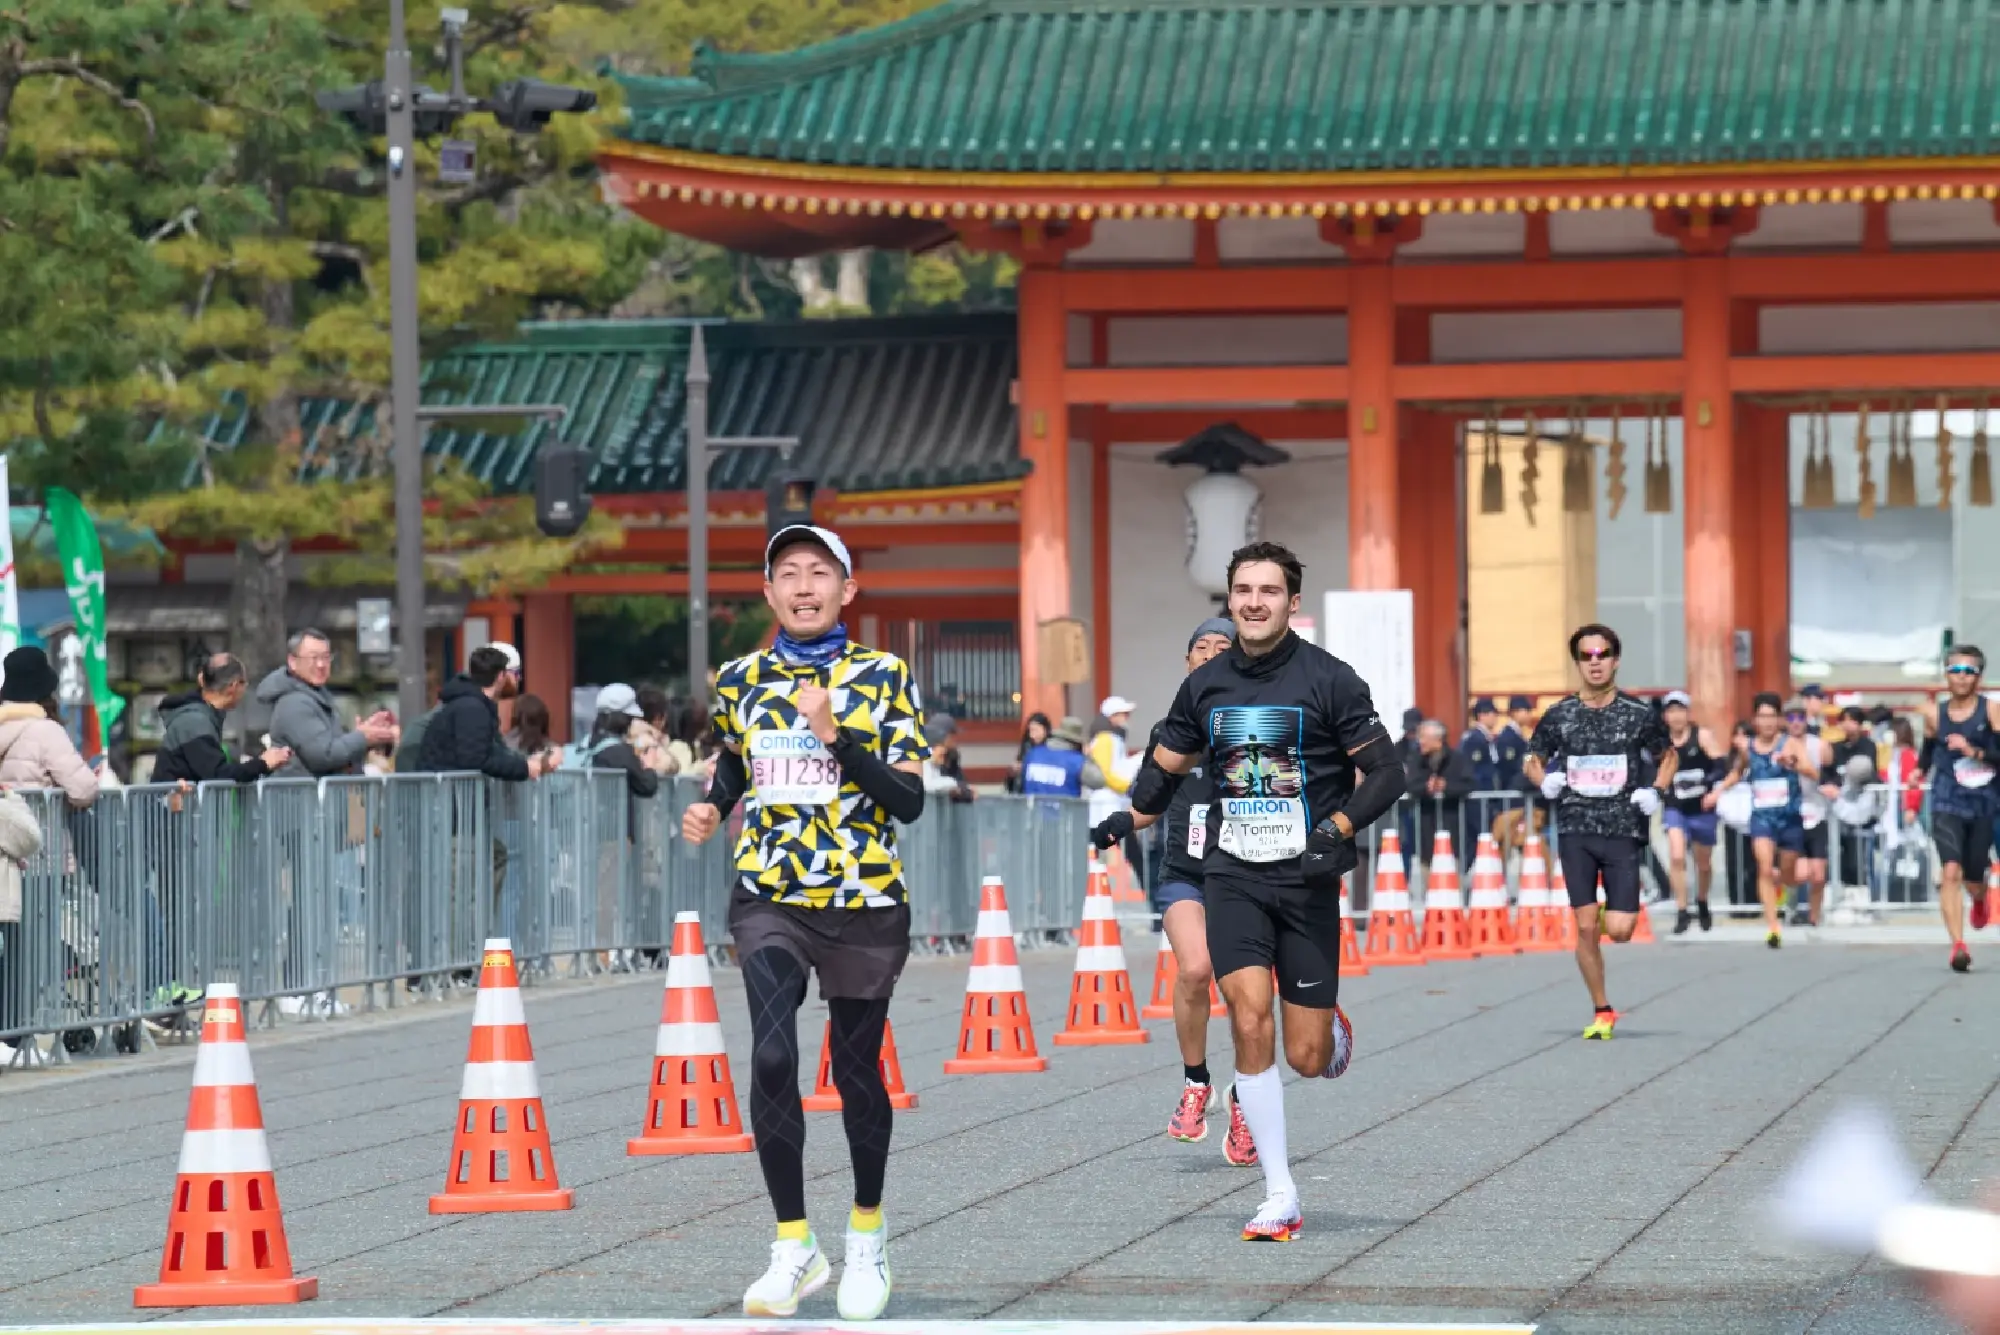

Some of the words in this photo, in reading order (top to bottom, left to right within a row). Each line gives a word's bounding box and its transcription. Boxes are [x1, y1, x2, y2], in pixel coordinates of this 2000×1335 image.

[1213, 712, 1223, 736] 2025
[770, 758, 838, 786] 11238
[1191, 827, 1200, 839] S
[1223, 823, 1234, 837] A
[1240, 823, 1293, 837] Tommy
